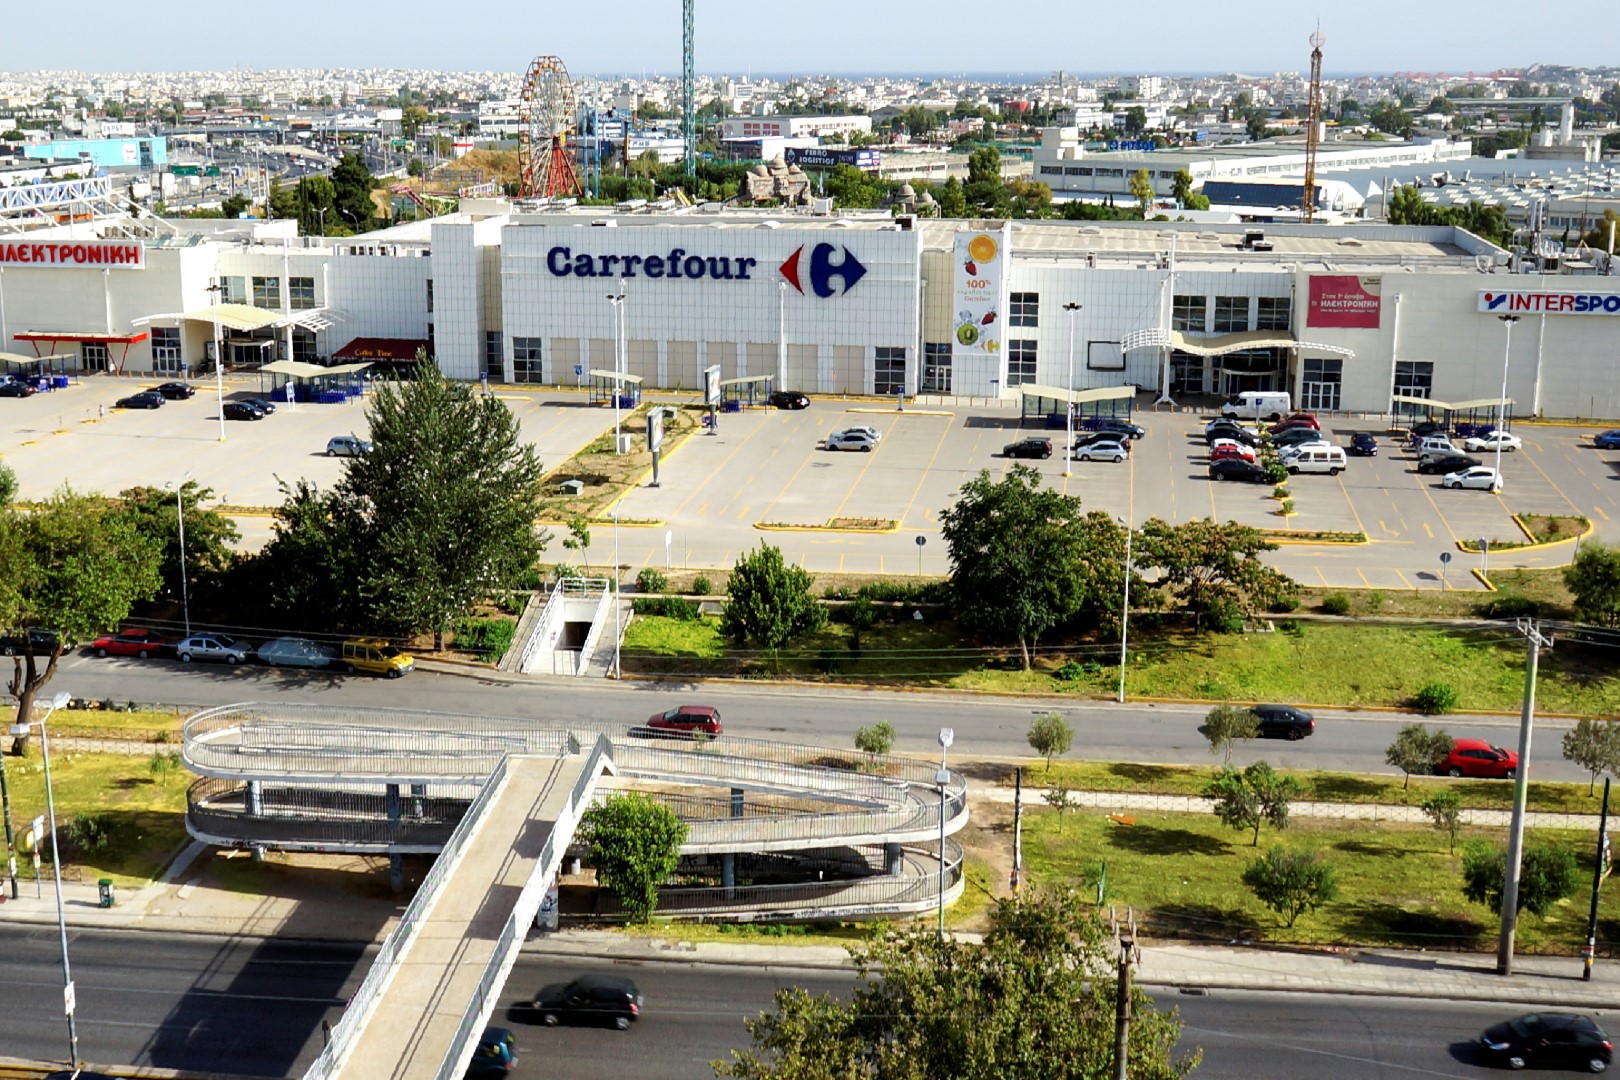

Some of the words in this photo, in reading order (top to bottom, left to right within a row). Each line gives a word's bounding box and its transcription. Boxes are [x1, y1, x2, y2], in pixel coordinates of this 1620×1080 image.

[0, 243, 139, 264] ΛΕΚΤΡΟΝΙΚΗ
[547, 246, 756, 280] Carrefour
[1320, 300, 1378, 308] ΗΛΕΚΤΡΟΝΙΚΗ
